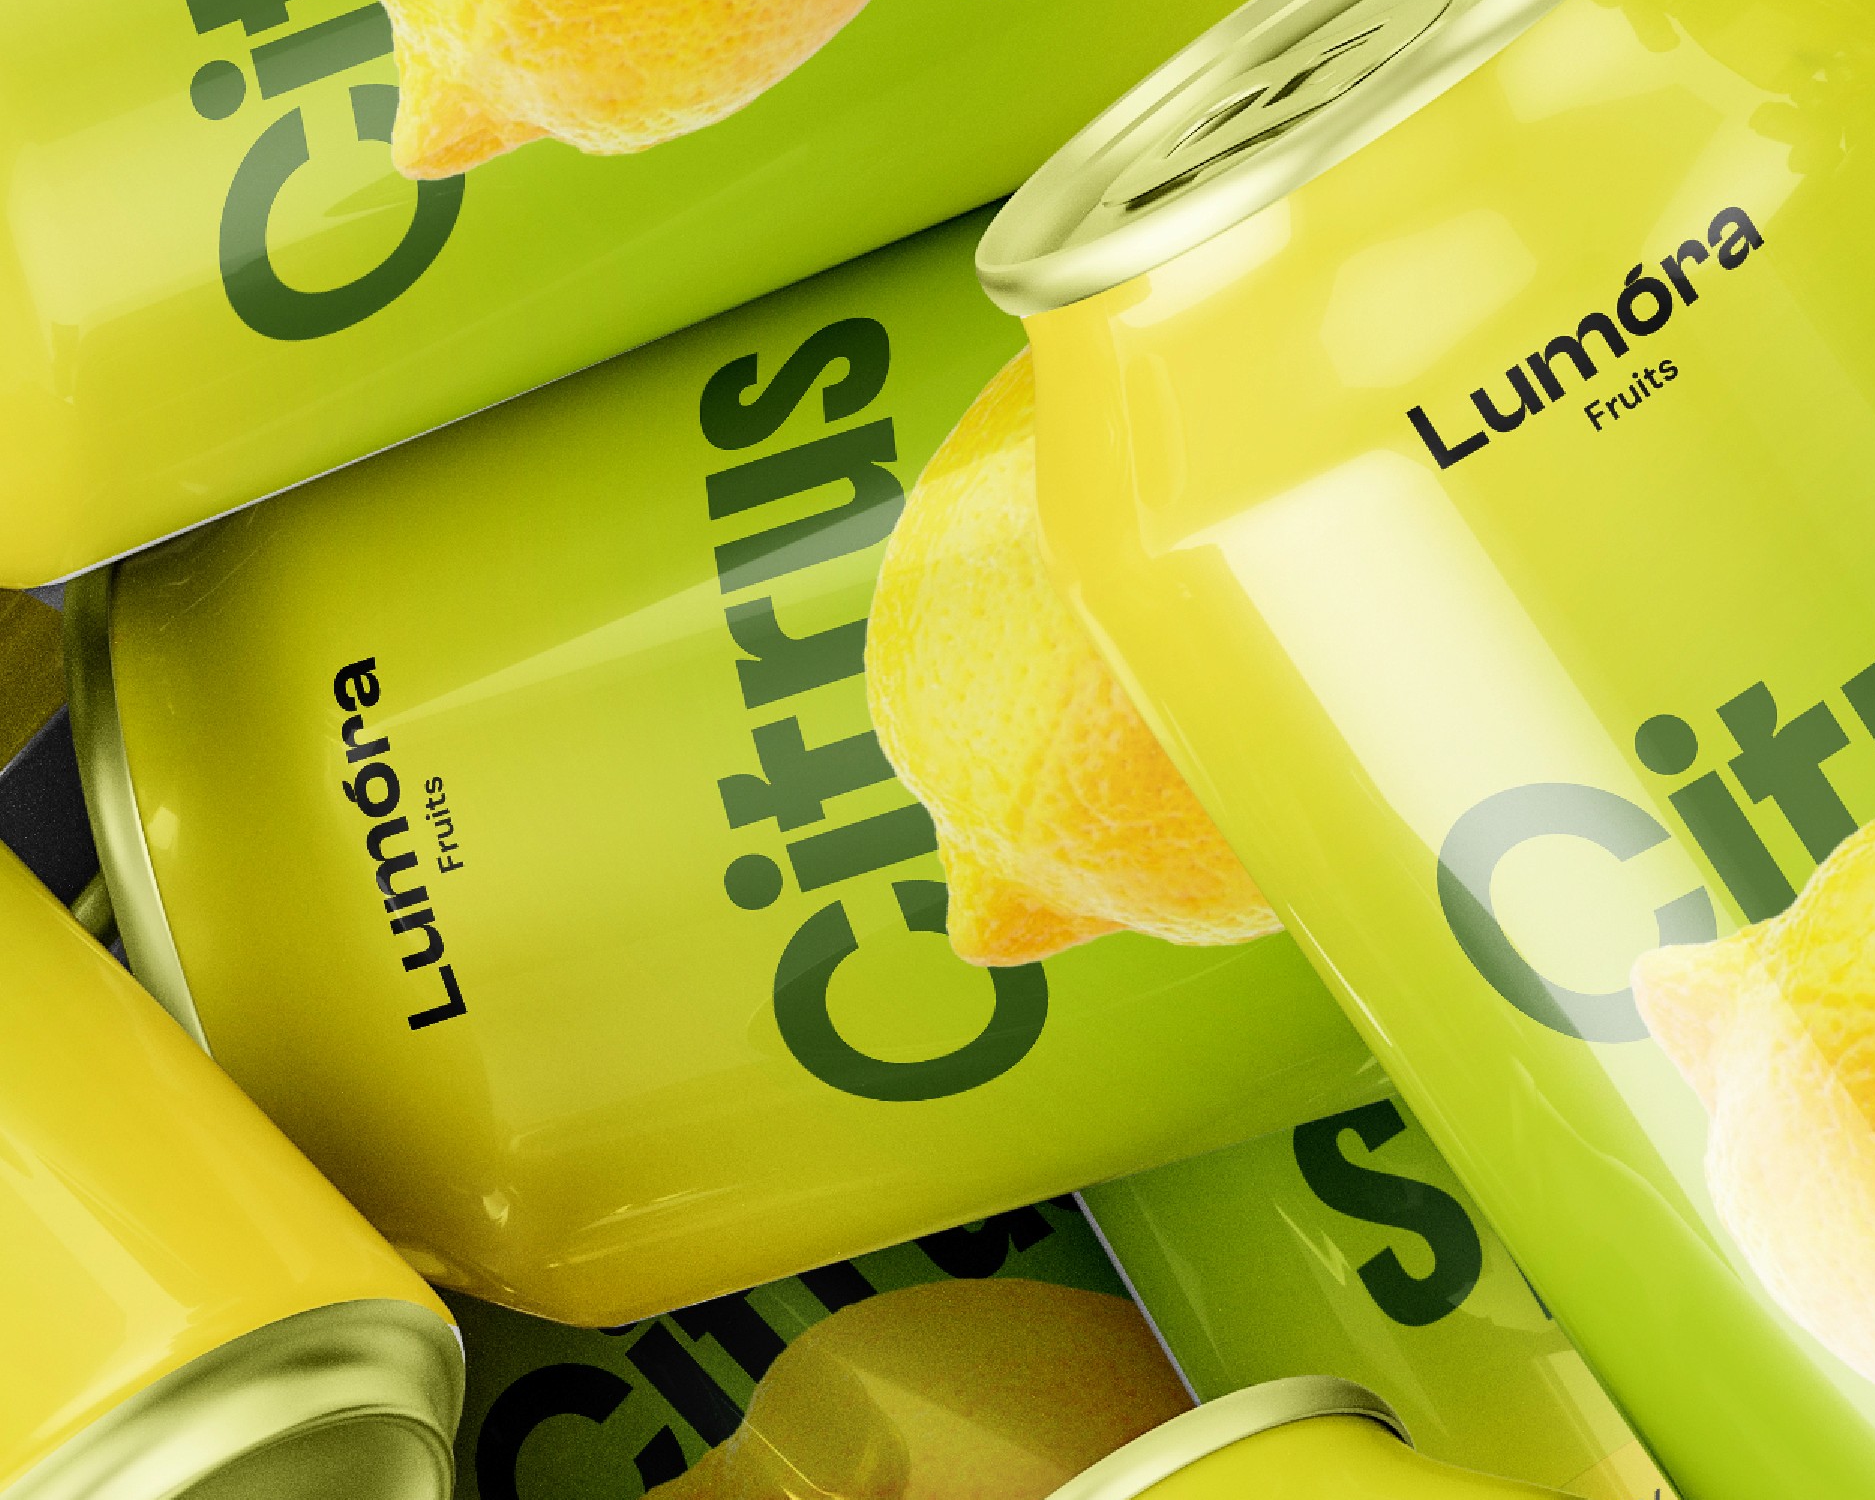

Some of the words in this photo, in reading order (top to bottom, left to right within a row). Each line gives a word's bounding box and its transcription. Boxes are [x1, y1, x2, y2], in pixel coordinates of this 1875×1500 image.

[1406, 205, 1765, 470] Lumóra
[1584, 355, 1680, 433] Fruits
[425, 774, 464, 875] Fruits
[699, 318, 1048, 1102] Citrus
[332, 658, 468, 1030] Lumóra
